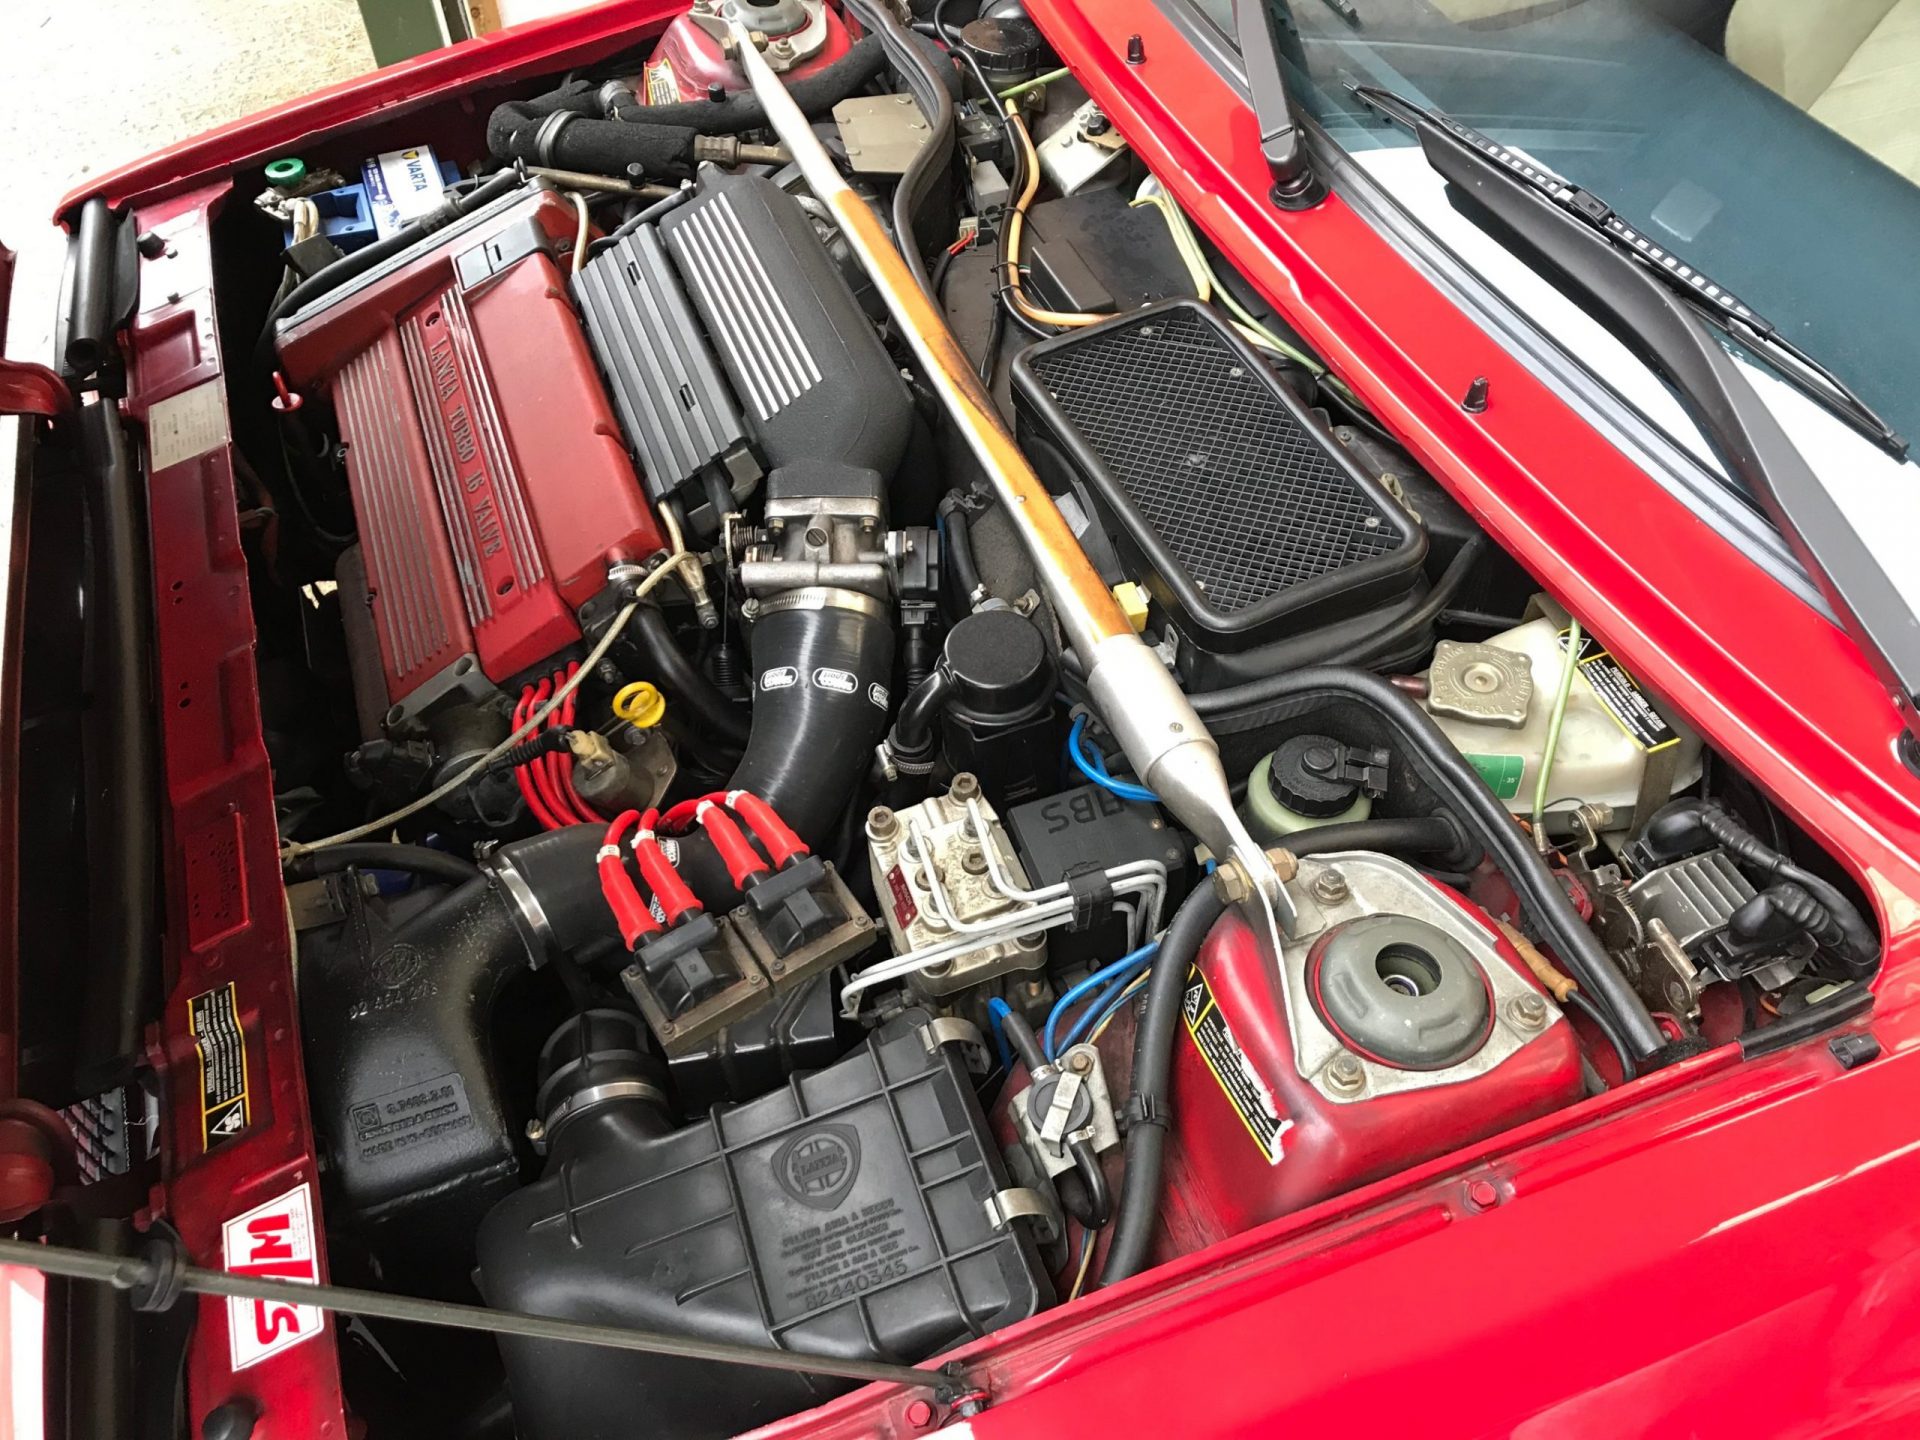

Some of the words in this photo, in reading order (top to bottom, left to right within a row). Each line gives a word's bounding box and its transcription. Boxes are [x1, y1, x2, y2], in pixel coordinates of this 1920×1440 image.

[407, 160, 428, 191] VARTA
[430, 335, 459, 403] LANCIA
[449, 404, 476, 463] TURBO
[465, 469, 484, 493] 16
[474, 495, 503, 557] VALVE
[1041, 788, 1124, 834] ABS
[805, 1258, 907, 1309] 82440345
